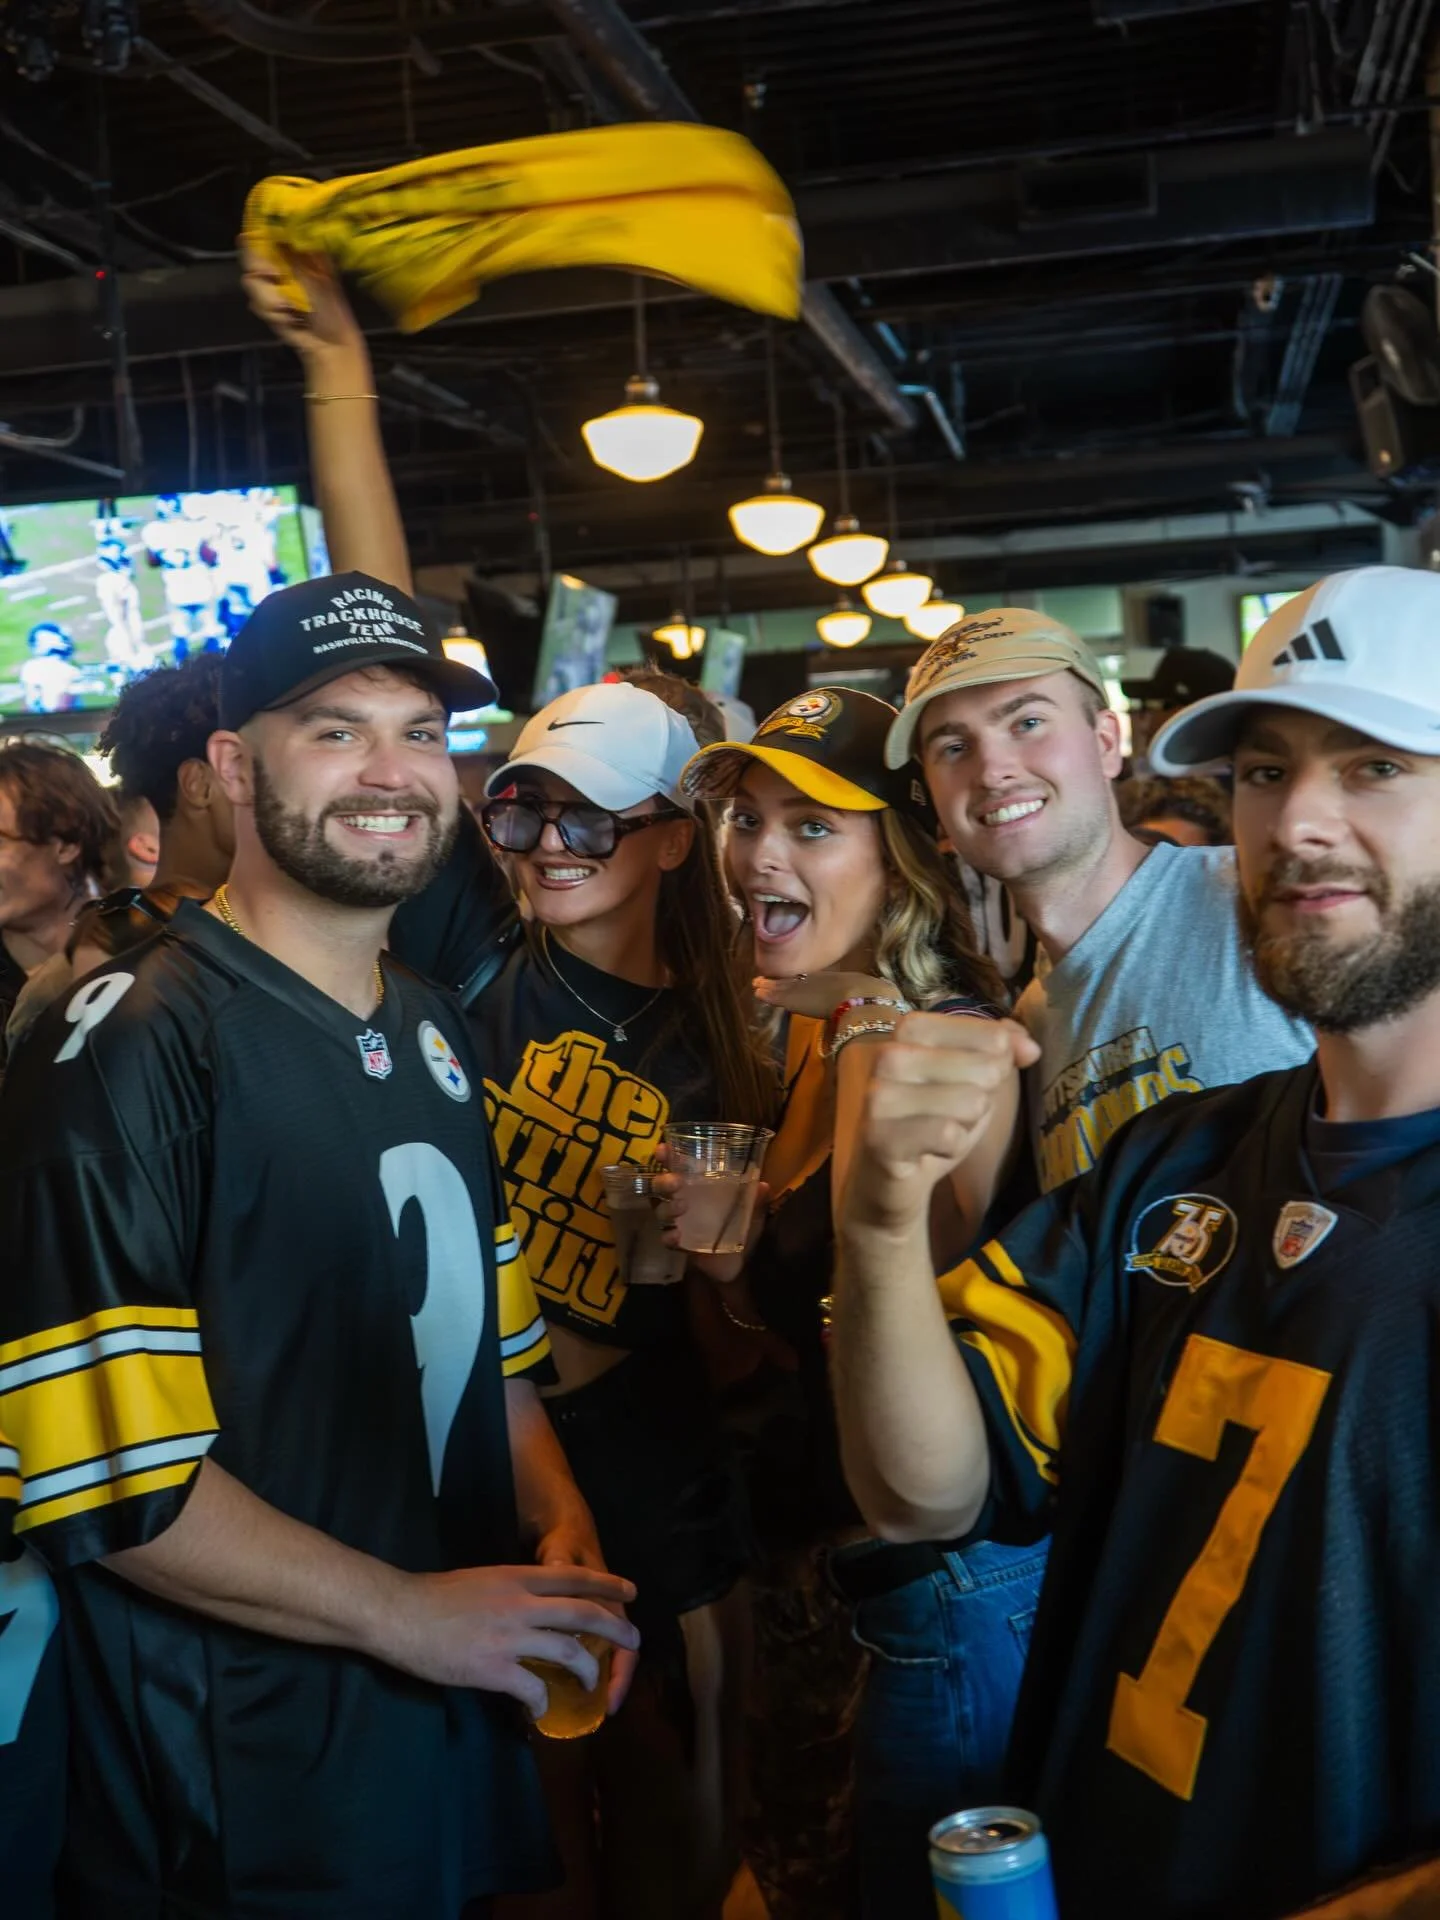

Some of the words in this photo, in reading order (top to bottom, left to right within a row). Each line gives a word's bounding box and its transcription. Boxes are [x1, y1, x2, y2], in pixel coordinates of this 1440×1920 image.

[299, 607, 426, 636] TRACKHOUSE
[330, 588, 394, 610] RACING
[349, 621, 397, 636] TEAM
[53, 971, 136, 1063] 9
[526, 1040, 662, 1138] the
[1158, 1199, 1228, 1265] 75
[1106, 1333, 1333, 1802] 7
